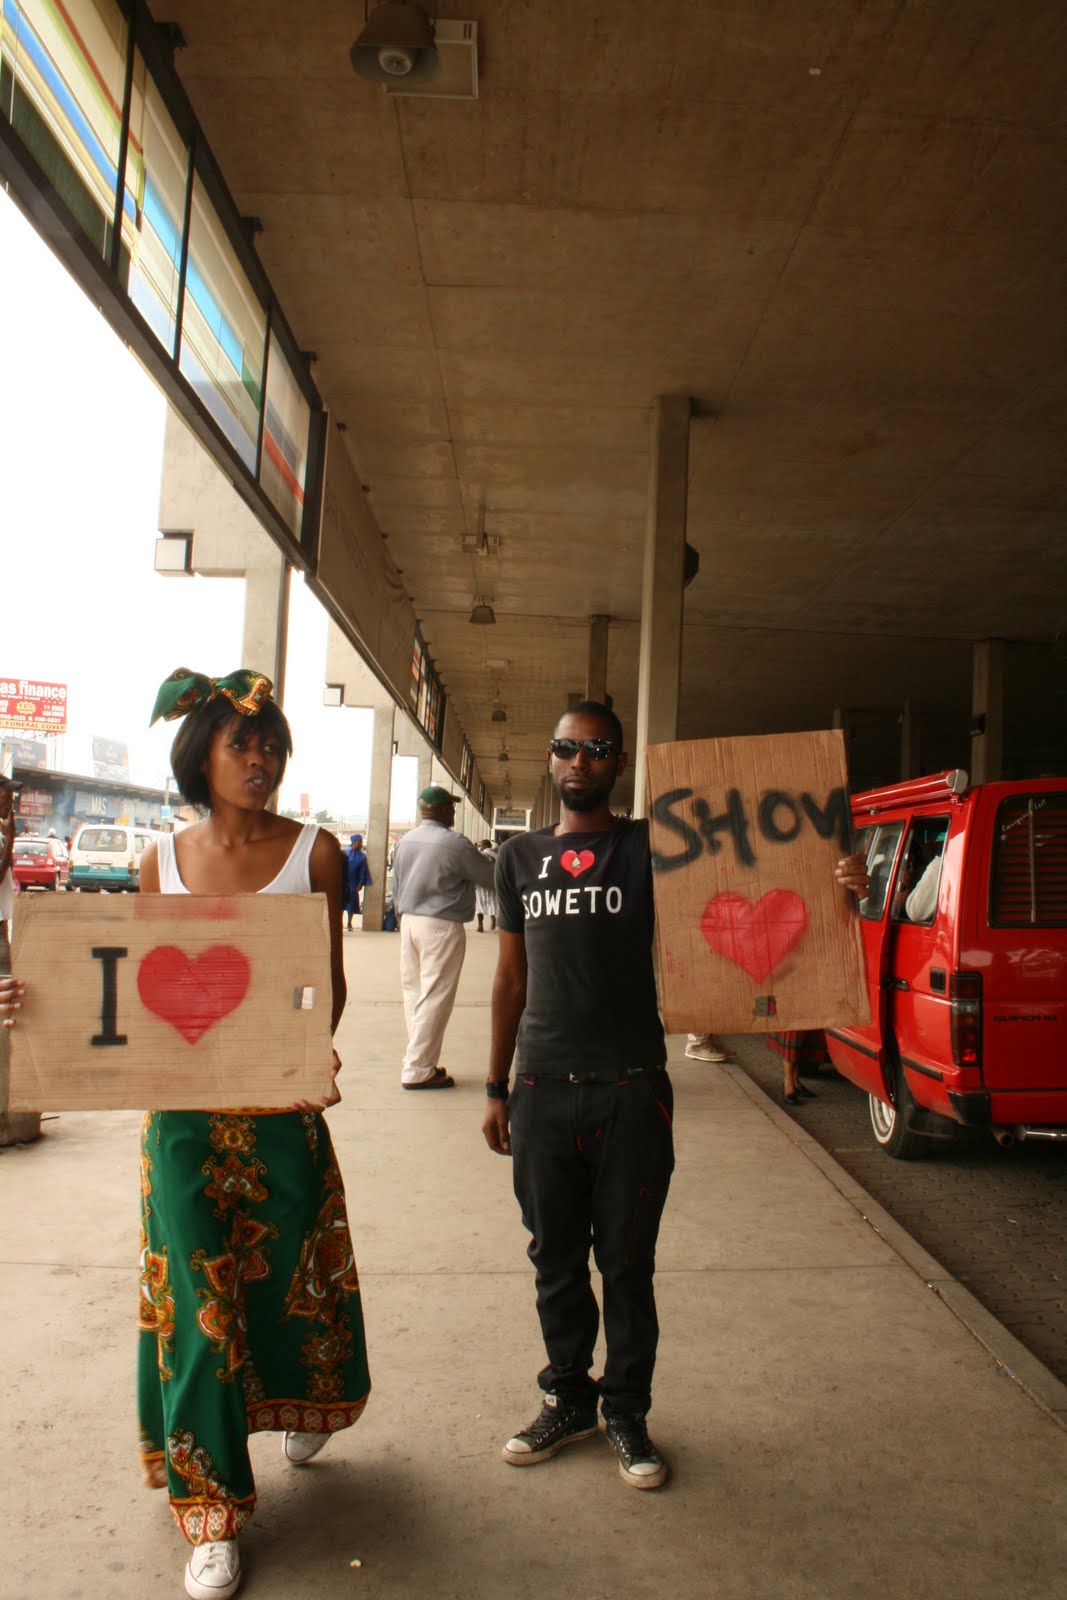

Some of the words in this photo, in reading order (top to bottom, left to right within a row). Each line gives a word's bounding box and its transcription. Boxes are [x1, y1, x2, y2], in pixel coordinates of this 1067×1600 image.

[19, 680, 66, 699] finance
[5, 721, 39, 729] FUNERAL
[538, 856, 552, 879] I
[522, 886, 623, 920] SOWETO
[91, 947, 128, 1046] I
